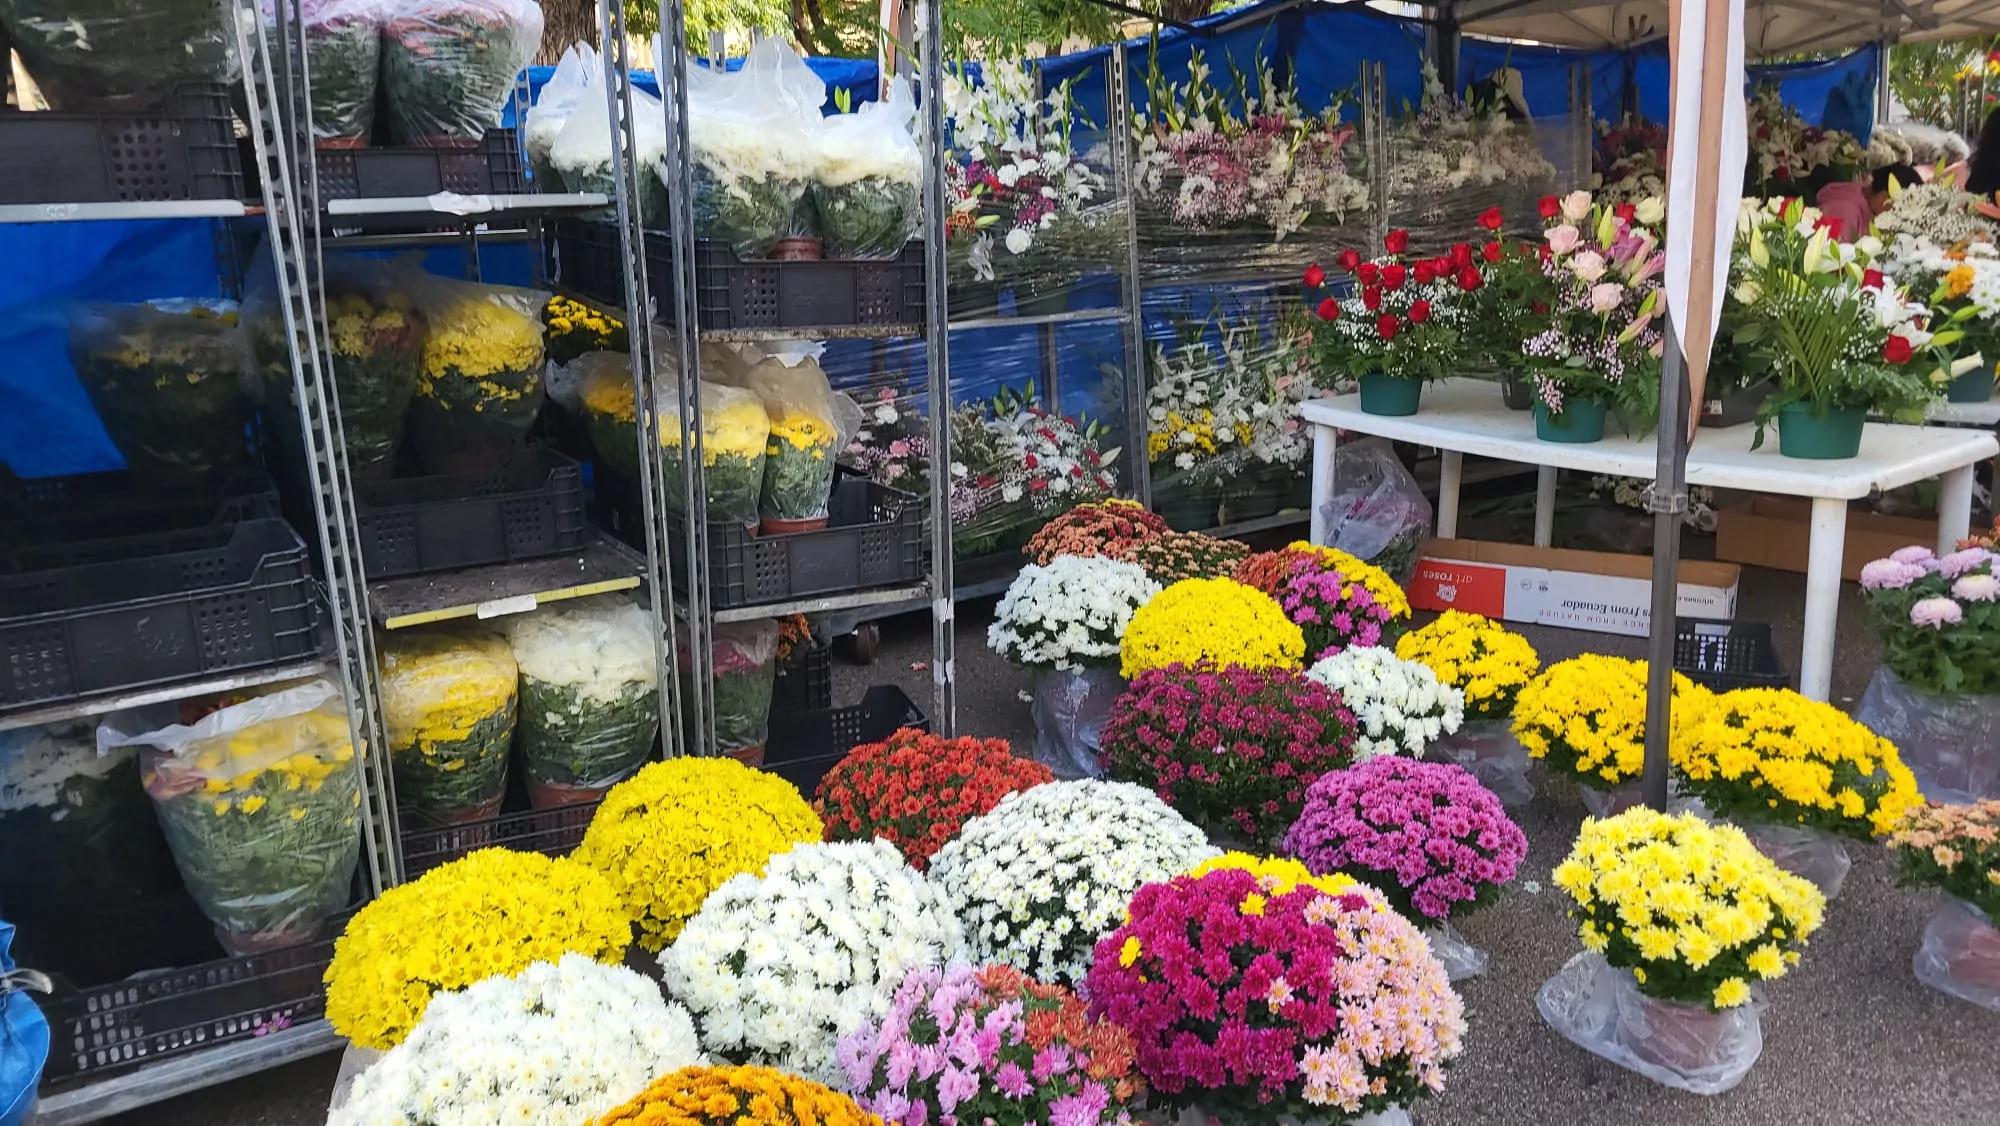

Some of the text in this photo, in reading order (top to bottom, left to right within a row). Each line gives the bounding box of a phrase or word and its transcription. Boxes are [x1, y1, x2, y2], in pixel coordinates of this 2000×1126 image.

[1423, 570, 1473, 585] art roses
[1560, 599, 1608, 615] Ecuador
[1610, 604, 1641, 617] from
